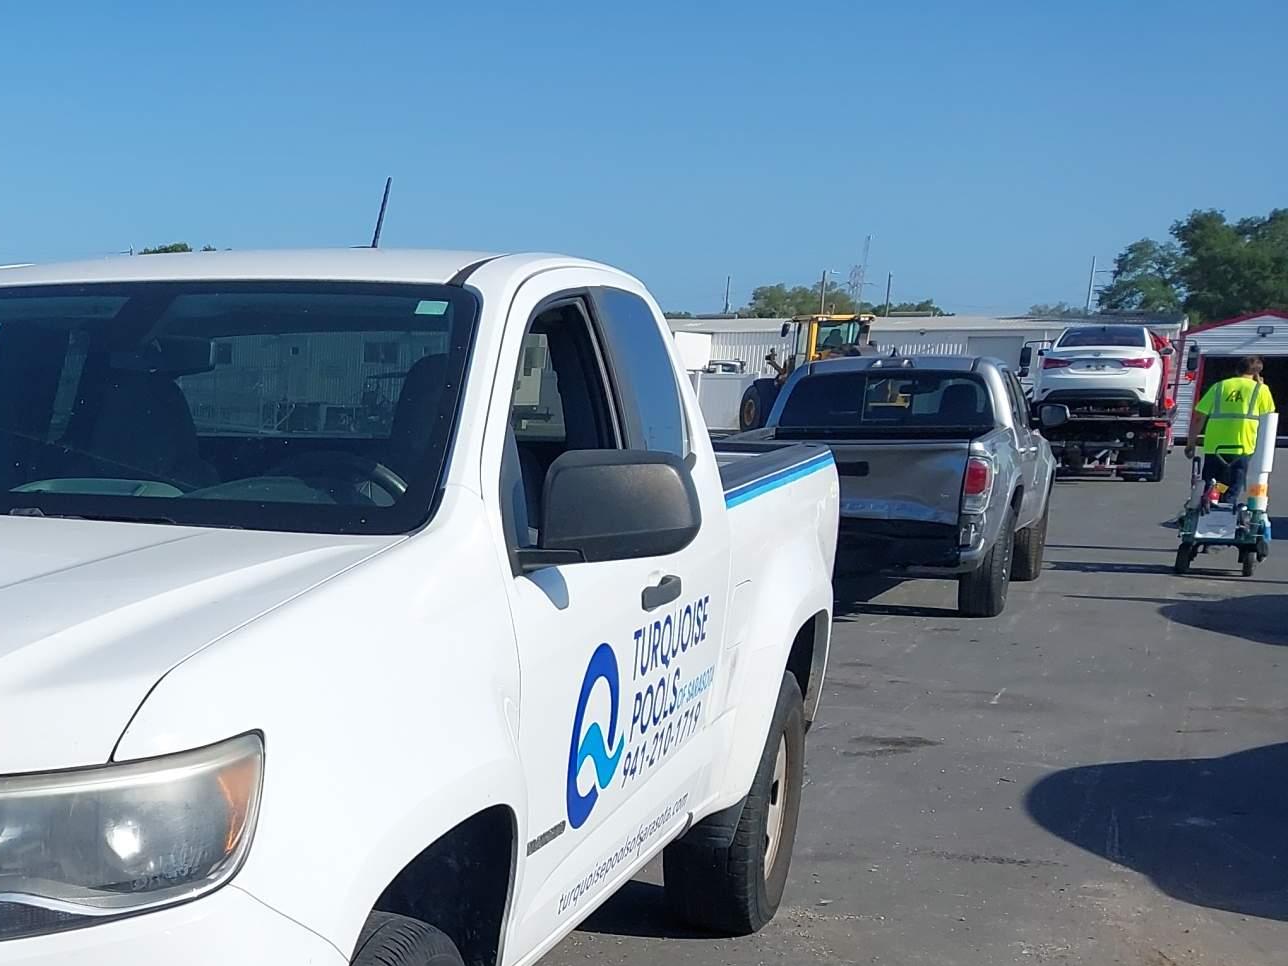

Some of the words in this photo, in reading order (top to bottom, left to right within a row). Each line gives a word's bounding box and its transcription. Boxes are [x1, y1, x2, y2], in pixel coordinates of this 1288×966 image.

[633, 595, 710, 681] TURQUOISE
[621, 701, 702, 789] 941-210-1719
[629, 667, 681, 743] POOLS
[557, 792, 689, 915] turquoisepoolsofsarasota.com
